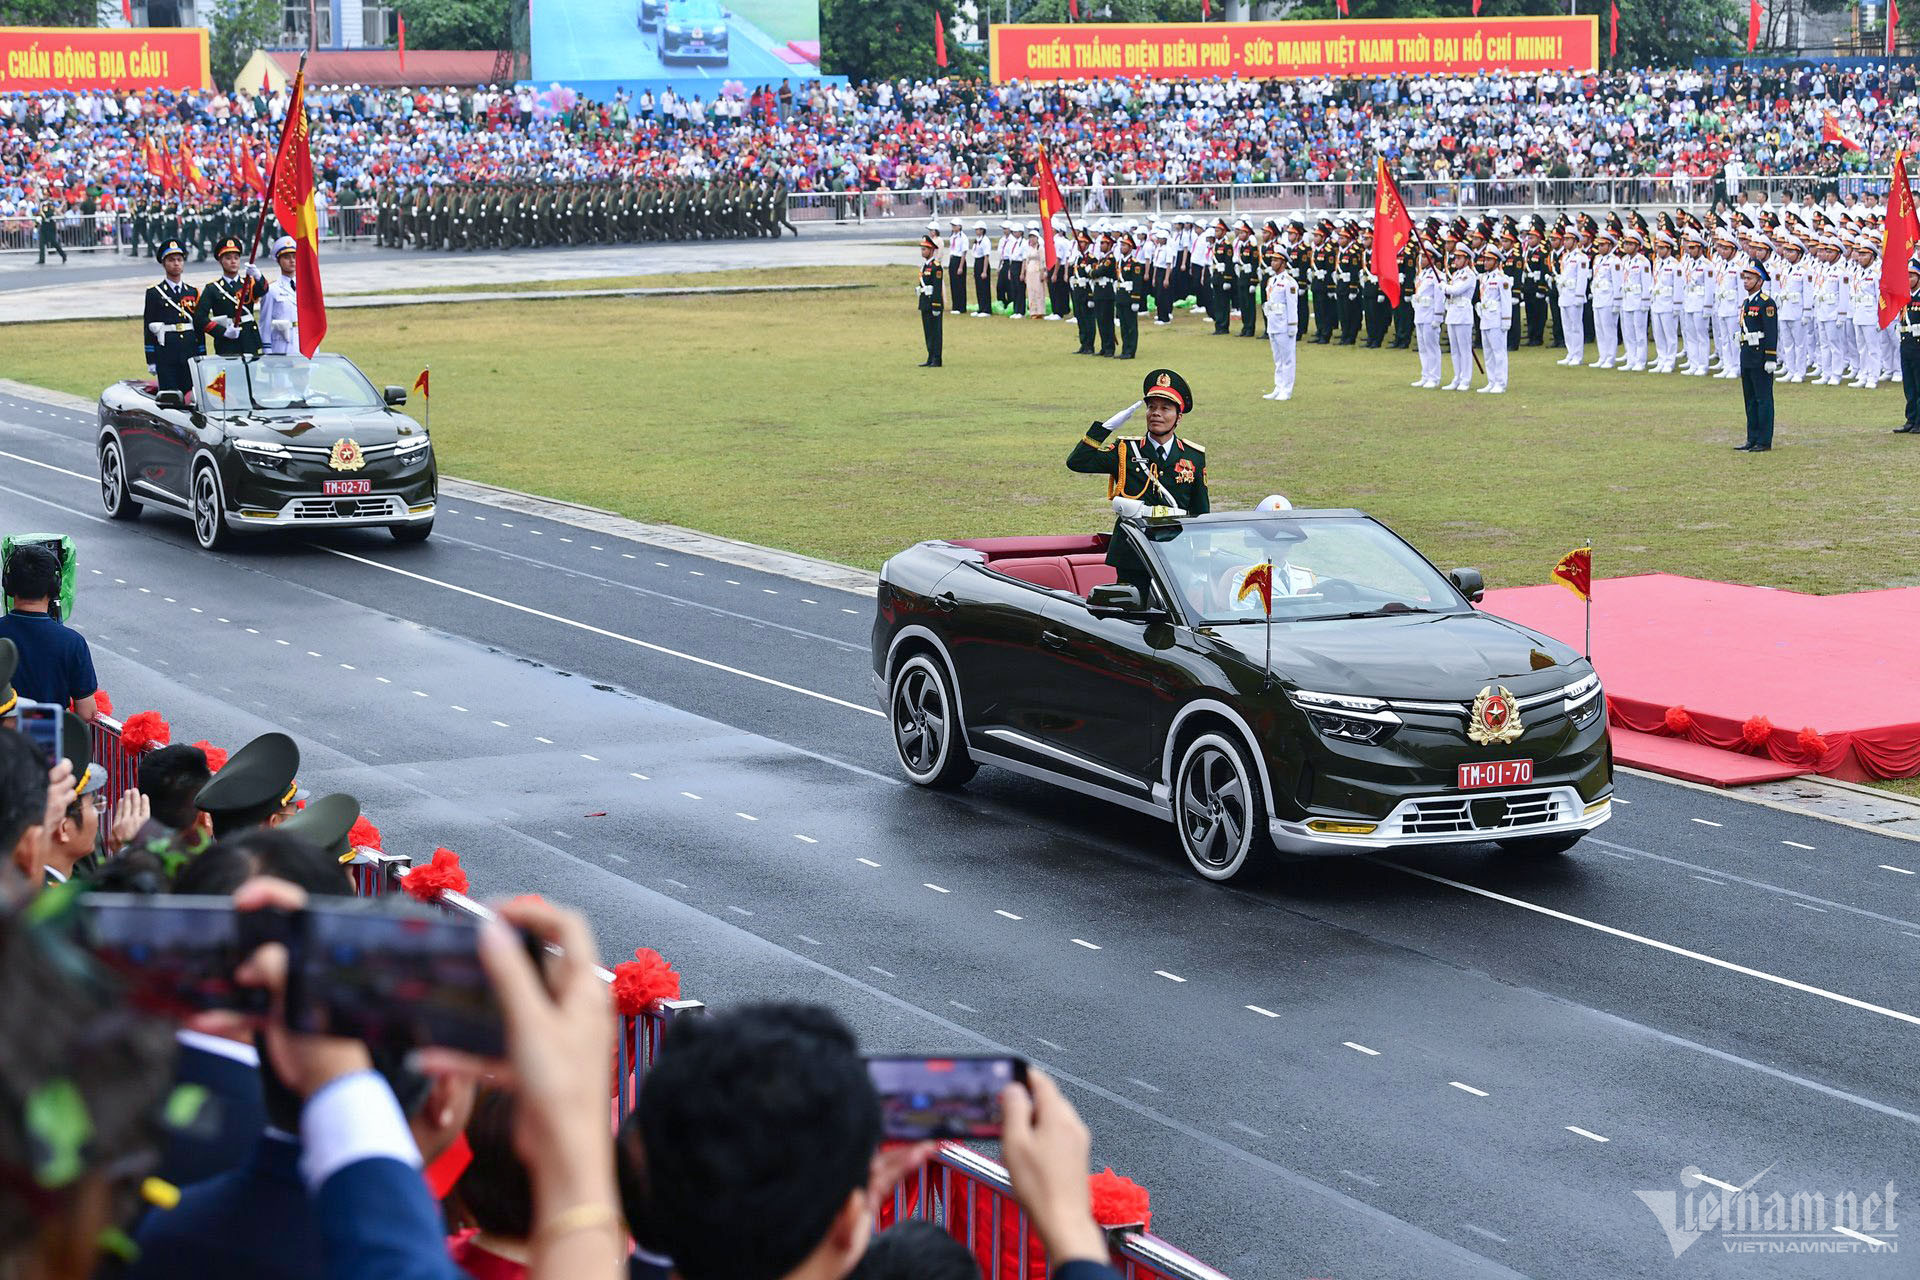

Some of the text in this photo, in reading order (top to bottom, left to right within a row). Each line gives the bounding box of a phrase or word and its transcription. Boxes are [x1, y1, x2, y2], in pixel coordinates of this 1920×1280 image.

[8, 41, 50, 78] CHẤN
[53, 45, 96, 84] ĐỘNG
[99, 50, 126, 84] ĐỊA
[1027, 37, 1071, 68] CHIẾN
[1073, 35, 1121, 68] THẮNG
[1124, 39, 1159, 73] ĐIỆN
[1163, 38, 1197, 67] BIÊN
[1200, 34, 1230, 67] PHỦ
[1244, 37, 1273, 66] SỨC
[1277, 41, 1321, 70] MẠNH
[1324, 34, 1356, 69] VIỆT
[1359, 39, 1394, 63] NAM
[1397, 32, 1430, 63] THỜI
[1433, 38, 1459, 67] ĐẠI
[1487, 32, 1512, 61] CHÍ
[326, 482, 369, 493] TM-02-70
[1461, 763, 1530, 786] TM-01-70
